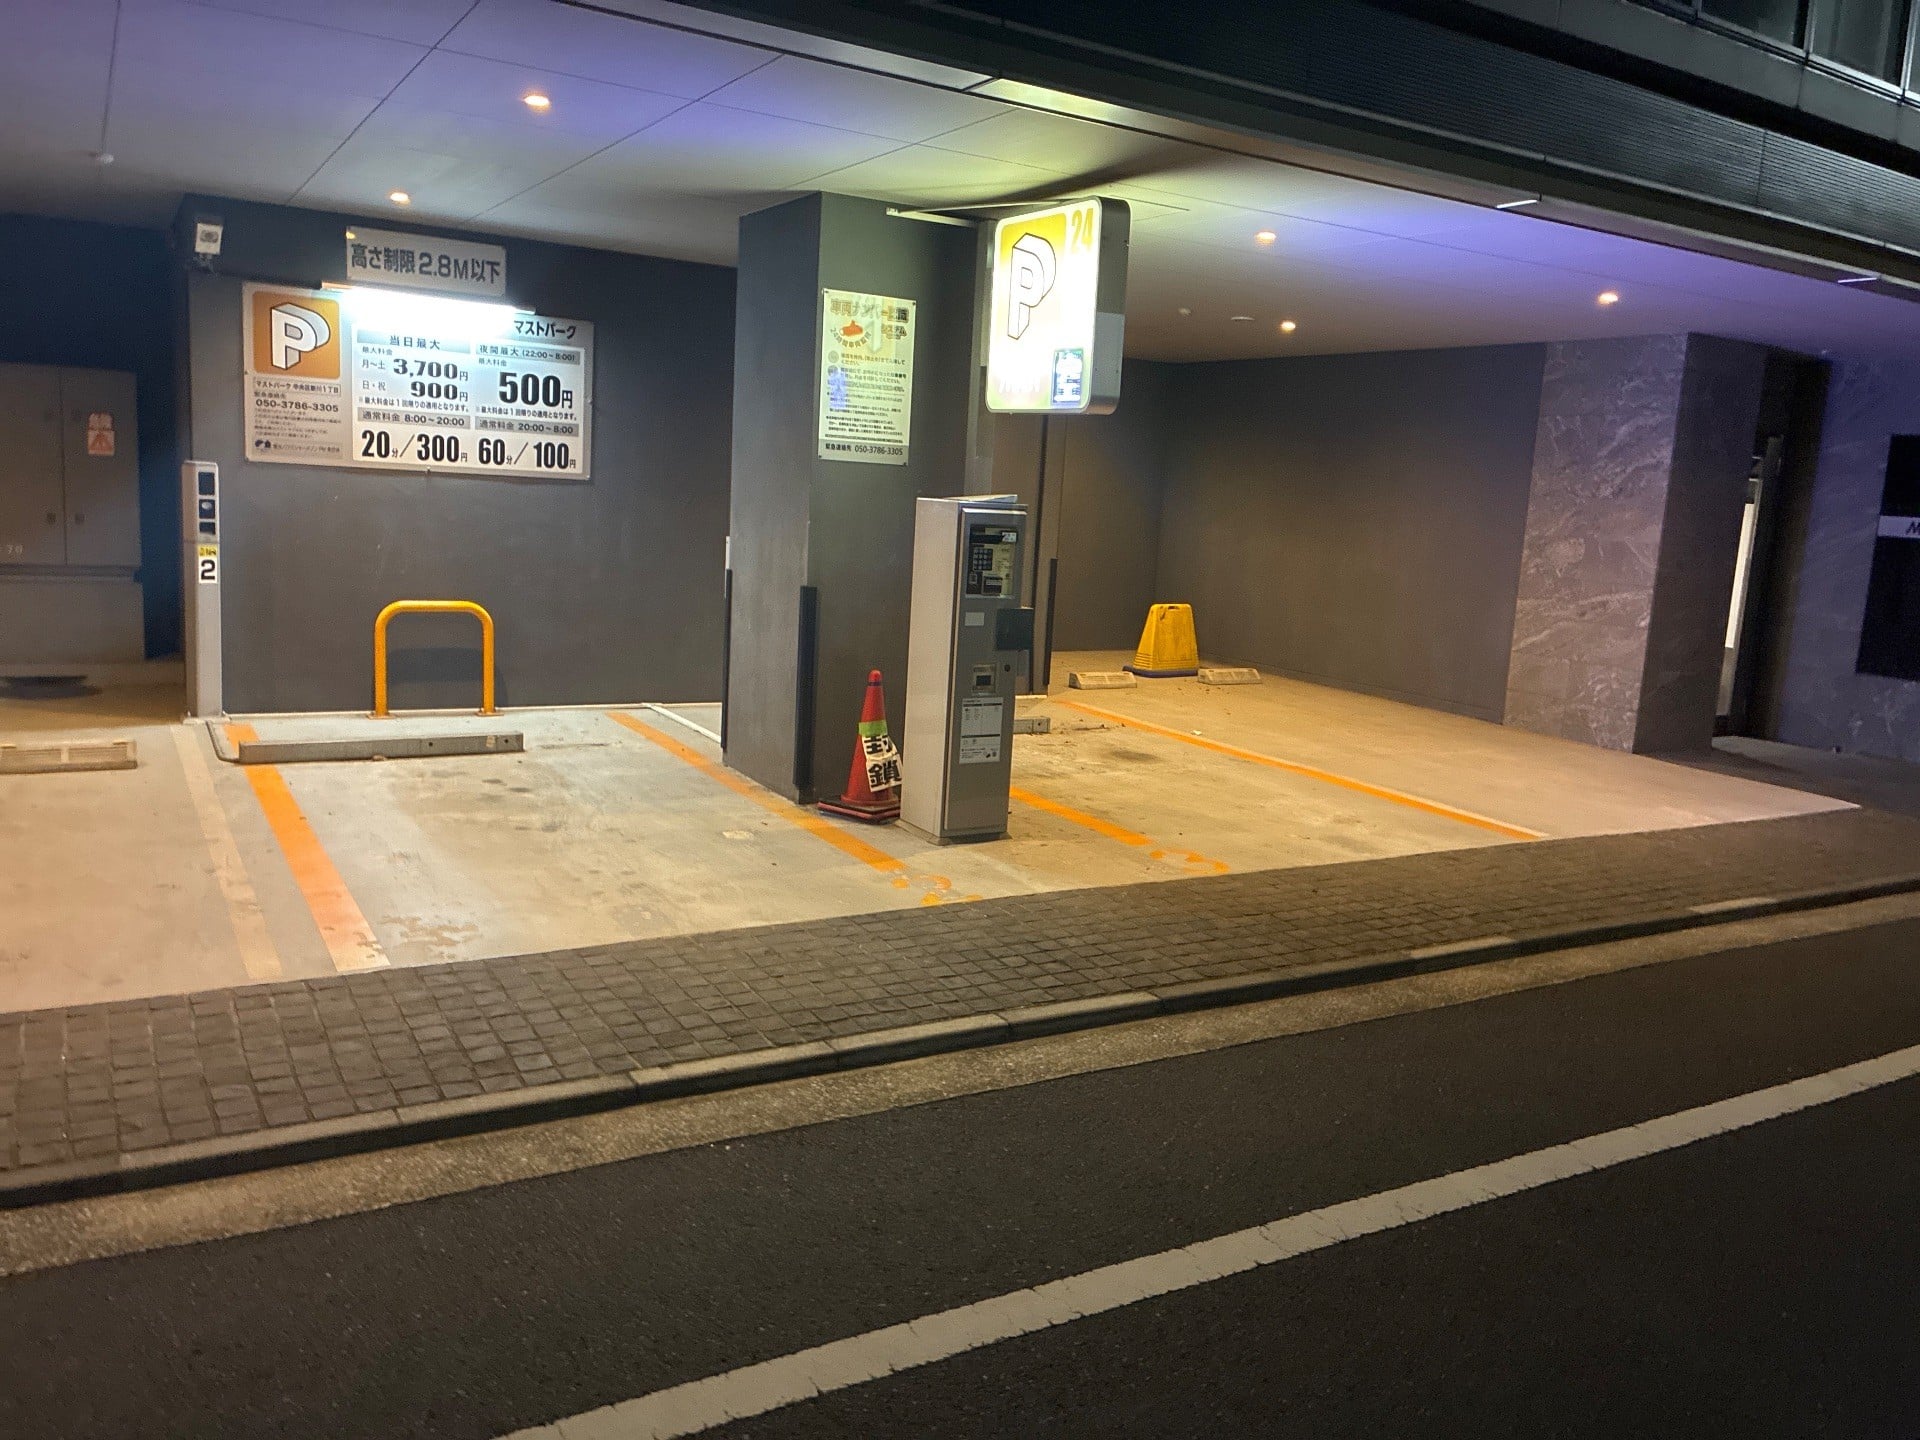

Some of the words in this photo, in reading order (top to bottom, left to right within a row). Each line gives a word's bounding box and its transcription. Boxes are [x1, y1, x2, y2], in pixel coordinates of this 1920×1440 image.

[351, 243, 500, 284] 高さ制限2.8M以下
[390, 336, 440, 350] 当日最大
[410, 381, 469, 402] 900円
[498, 371, 573, 409] 500円
[255, 399, 339, 413] 050-3786-3305
[362, 410, 401, 423] 通常料金
[854, 445, 904, 457] 050-3786-3305
[201, 559, 216, 580] 2
